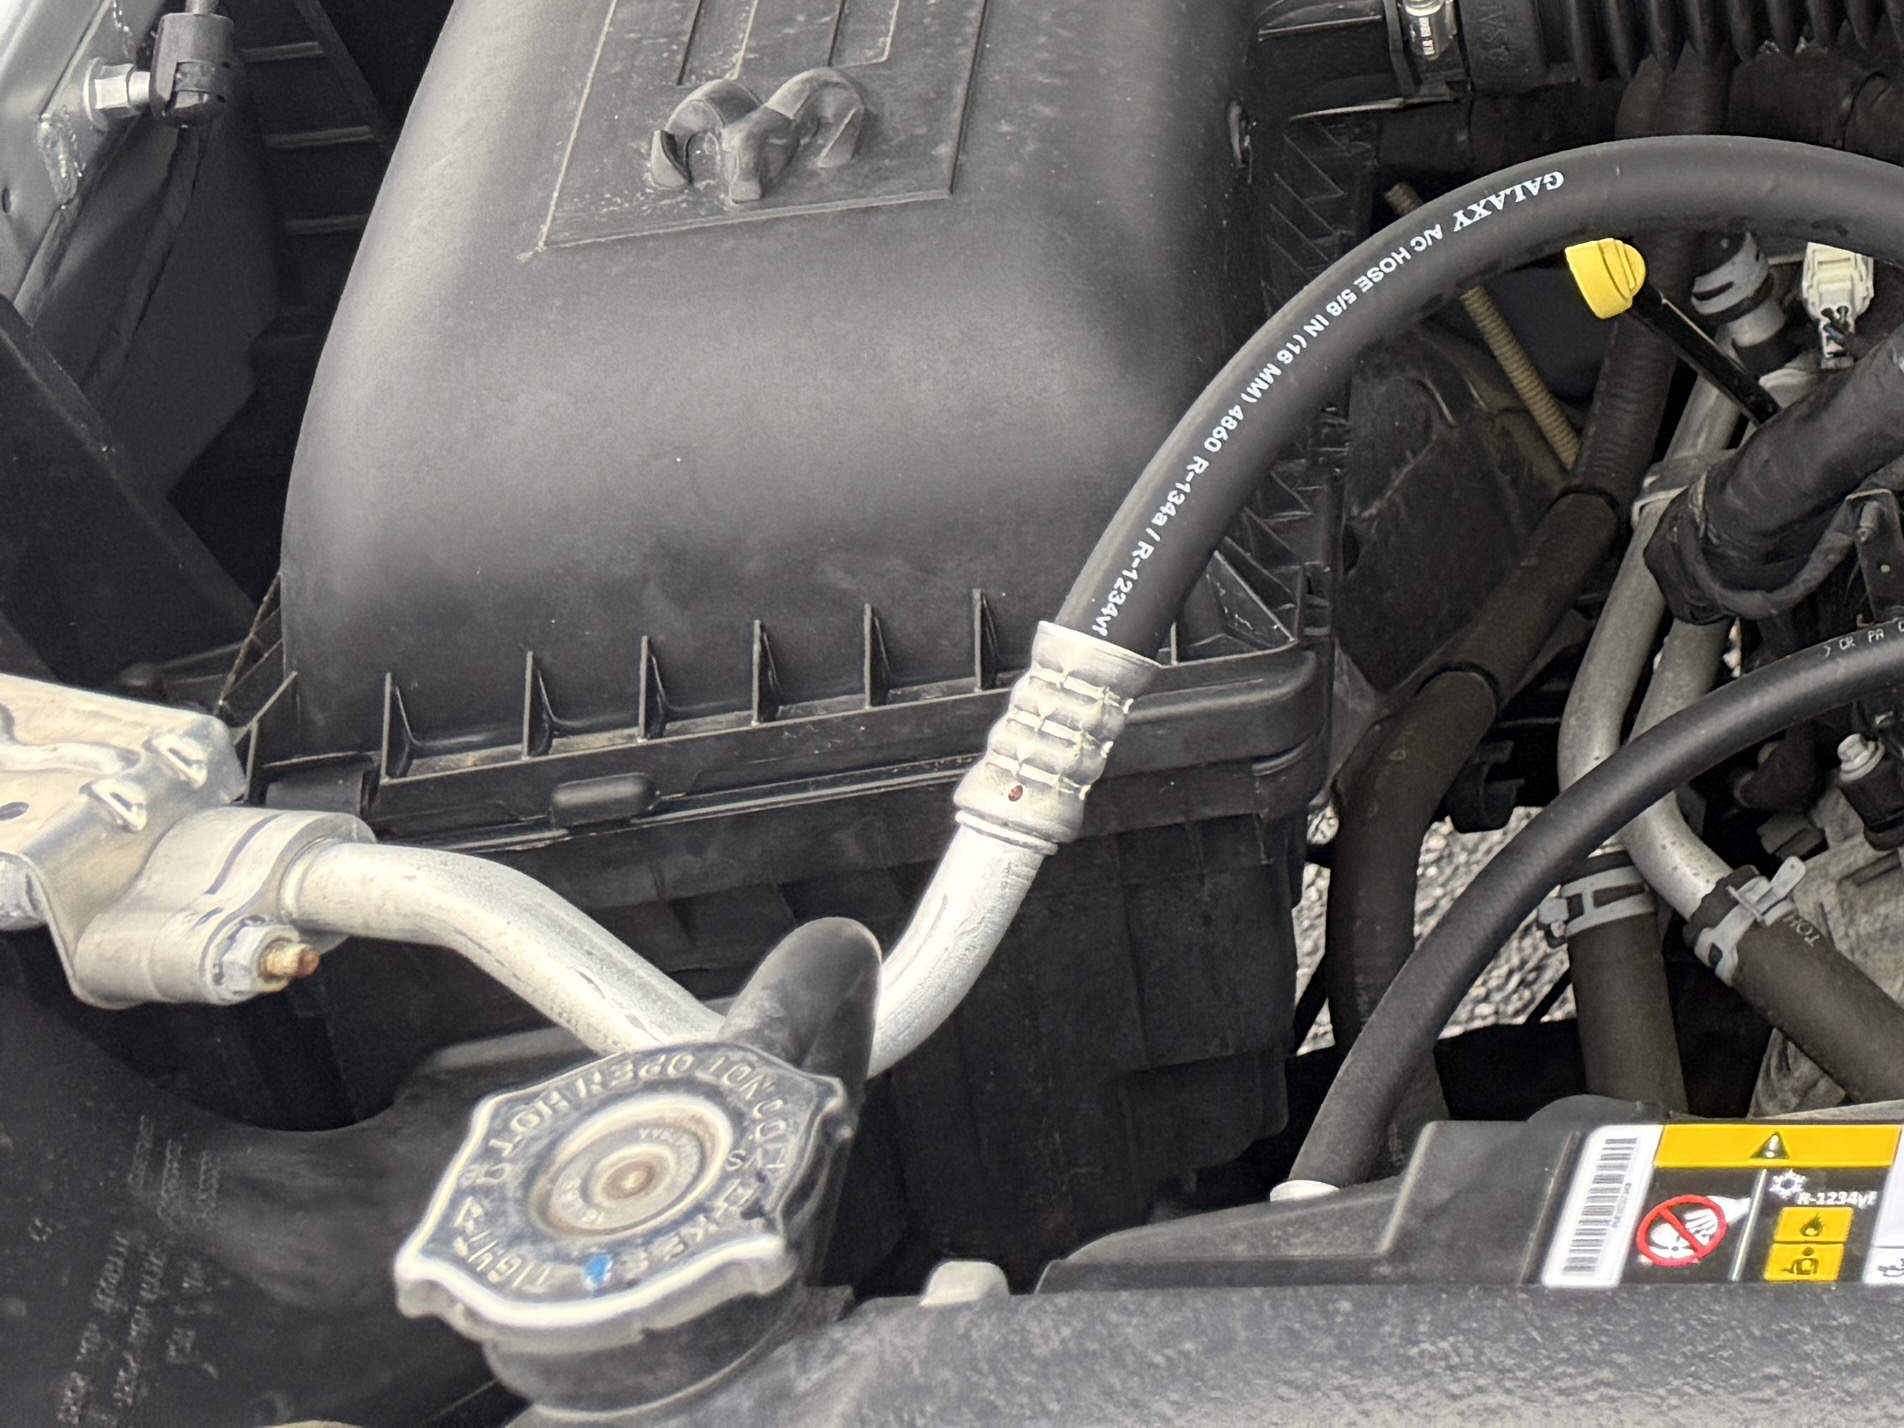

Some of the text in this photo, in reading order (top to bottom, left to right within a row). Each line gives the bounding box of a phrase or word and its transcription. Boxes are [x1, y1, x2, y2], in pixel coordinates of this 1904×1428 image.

[1452, 171, 1565, 232] GALAXY
[1410, 223, 1444, 252] A/C
[1352, 246, 1412, 294] HOSE
[1303, 311, 1331, 336] IN
[1325, 288, 1358, 319] 5/8
[1276, 333, 1310, 366] (16
[1246, 362, 1282, 404] MM)
[1202, 402, 1245, 454] 4860
[1151, 455, 1210, 527] R-134a
[1866, 628, 1885, 643] PA
[575, 1053, 693, 1099] OPEN
[693, 1055, 771, 1095] NOT
[488, 1087, 570, 1155] HOT
